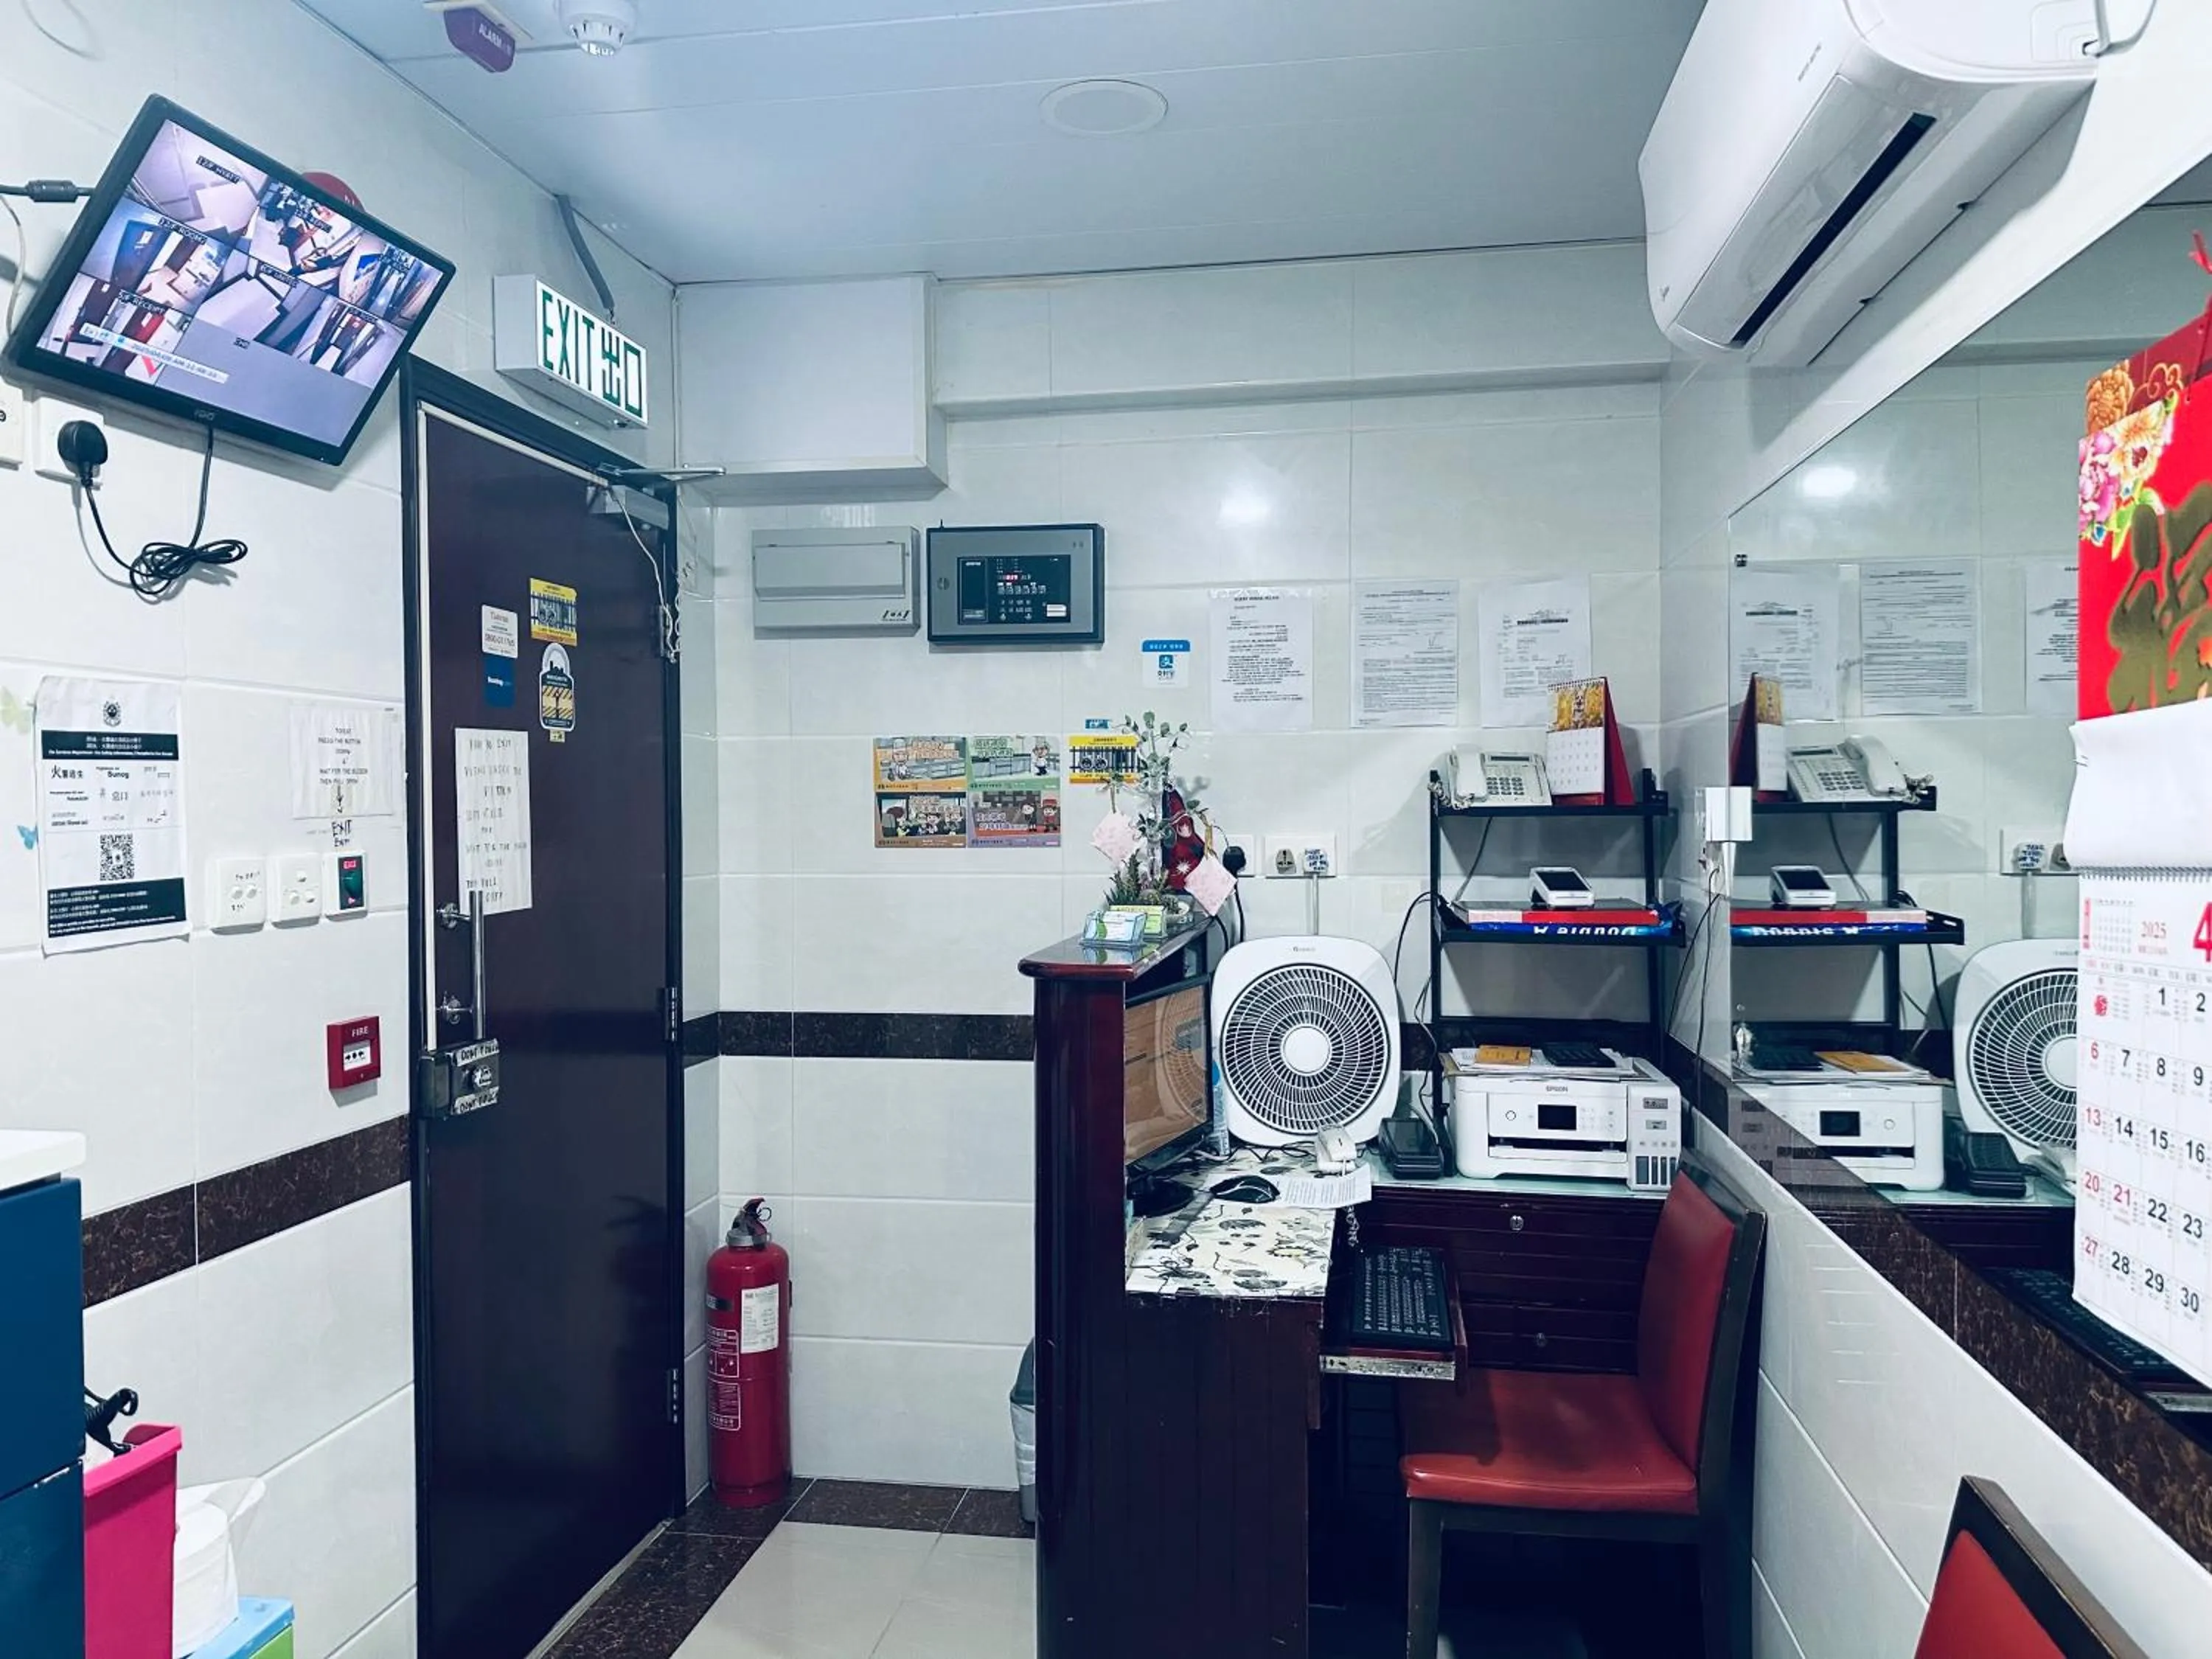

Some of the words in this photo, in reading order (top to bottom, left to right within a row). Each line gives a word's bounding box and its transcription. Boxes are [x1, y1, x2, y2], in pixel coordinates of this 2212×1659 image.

[542, 288, 595, 392] EXIT
[601, 322, 643, 419] 出口
[2140, 921, 2168, 939] 2025
[2193, 901, 2212, 963] 4
[2157, 987, 2166, 1006] 1
[2195, 992, 2206, 1012] 2
[352, 1026, 369, 1037] FIRE
[2090, 1041, 2100, 1060] 6
[2121, 1048, 2131, 1068] 7
[2156, 1057, 2166, 1077] 8
[2193, 1065, 2205, 1086] 9
[2085, 1107, 2101, 1127] 13
[2115, 1116, 2134, 1138] 14
[2149, 1127, 2169, 1150] 15
[2185, 1139, 2206, 1164] 16
[2084, 1171, 2100, 1193] 20
[2113, 1183, 2132, 1208] 21
[2147, 1197, 2168, 1224] 22
[2183, 1213, 2203, 1239] 23
[2084, 1236, 2098, 1257] 27
[2111, 1251, 2131, 1276] 28
[2144, 1267, 2165, 1293] 29
[2180, 1286, 2199, 1314] 30
